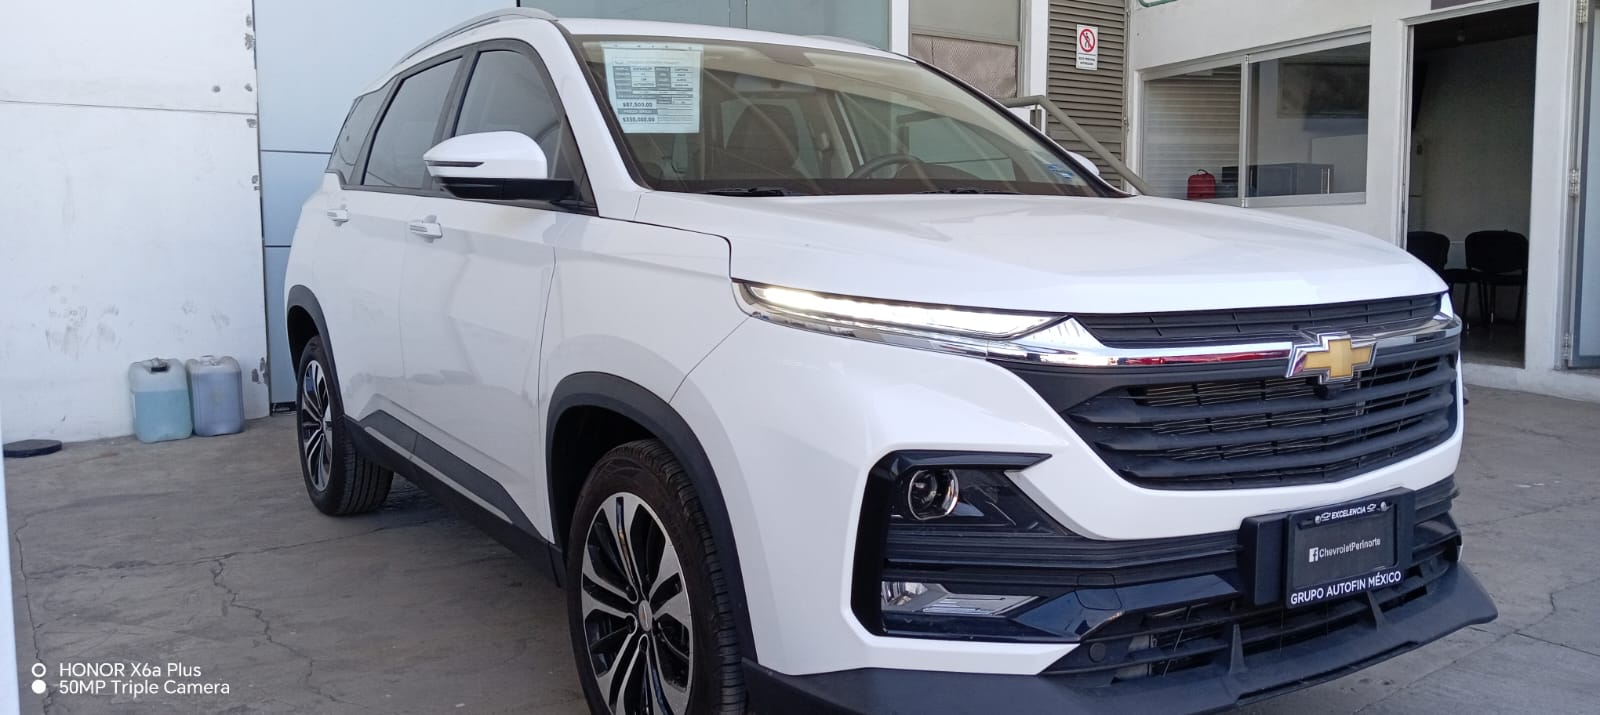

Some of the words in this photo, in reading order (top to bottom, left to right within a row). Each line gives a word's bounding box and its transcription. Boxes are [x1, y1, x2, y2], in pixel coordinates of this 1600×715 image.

[1331, 506, 1366, 519] EXCELENCIA
[1319, 538, 1381, 558] ChevroletPerinorte
[1290, 587, 1324, 605] GRUPO
[1326, 578, 1366, 598] AUTOFIN
[1368, 570, 1402, 588] MÉXICO
